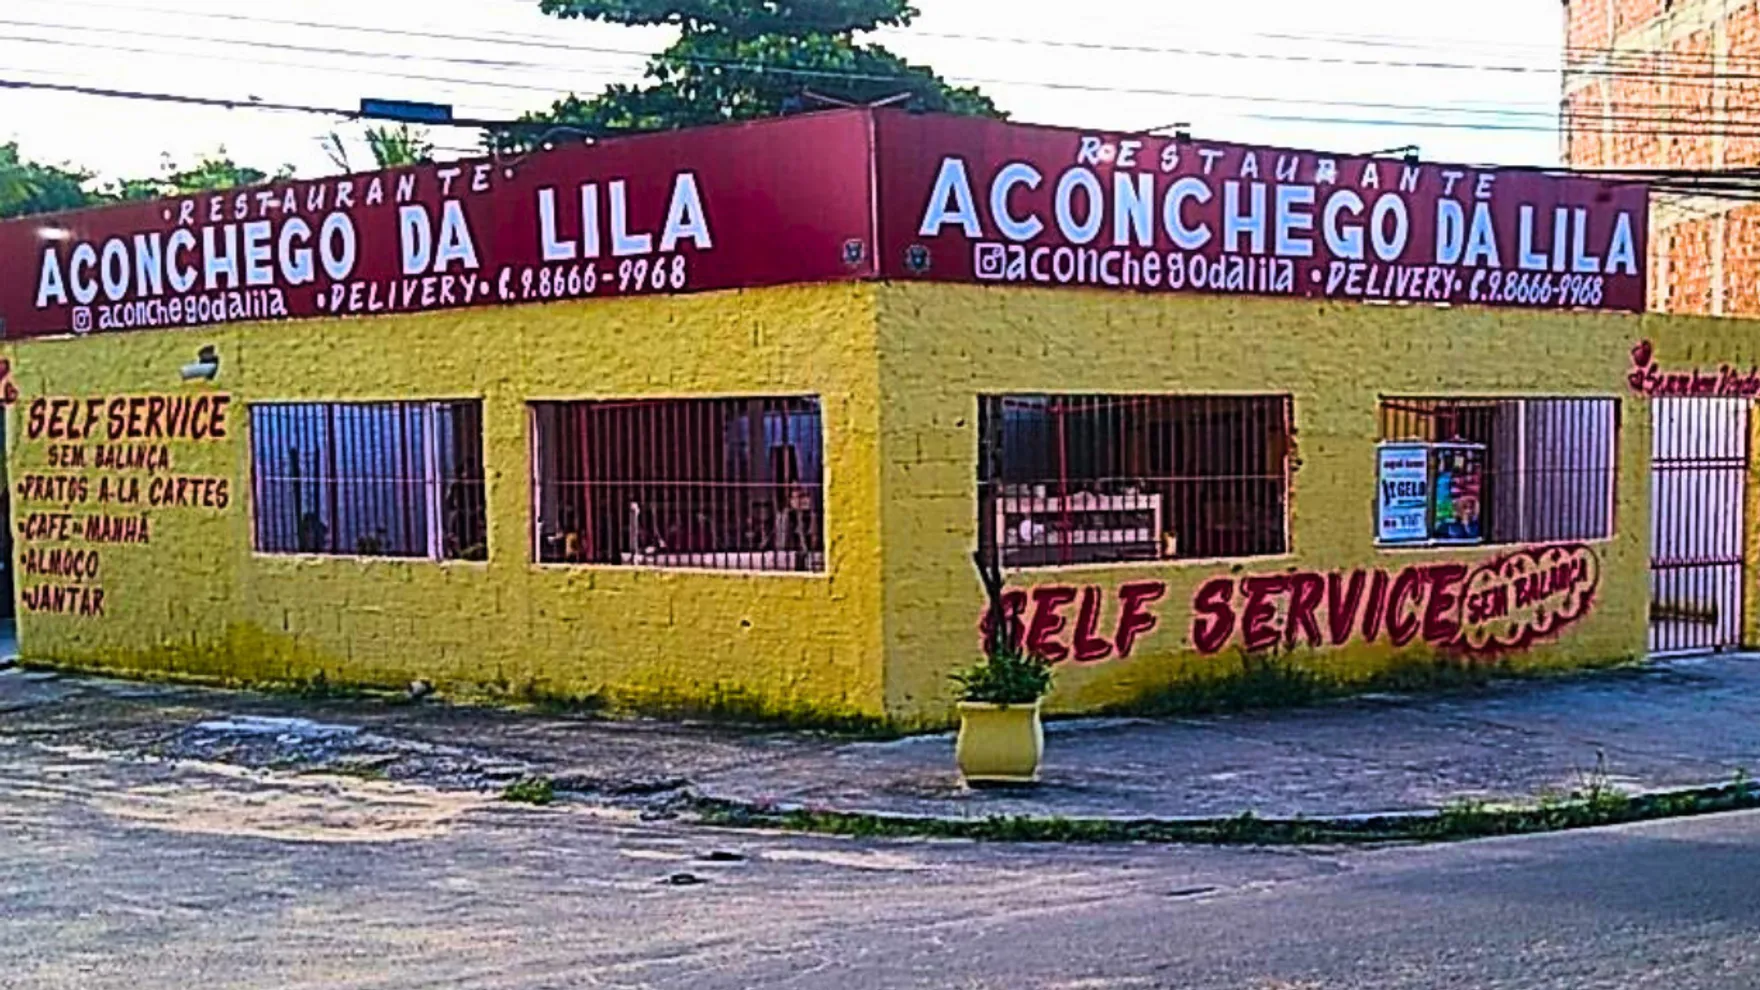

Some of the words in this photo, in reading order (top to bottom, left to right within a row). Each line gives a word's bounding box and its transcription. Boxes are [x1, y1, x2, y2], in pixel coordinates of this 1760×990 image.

[1078, 136, 1494, 197] RESTAURANTE
[178, 164, 491, 224] RESTAURANTE
[918, 157, 1409, 259] ACONCHEGO
[1436, 199, 1499, 269] DA
[1519, 206, 1637, 275] LILA
[36, 211, 356, 307] ACONCHEGO
[400, 200, 479, 275] DA
[538, 172, 712, 261] LILA
[1006, 243, 1294, 292] aconchegodalila
[1325, 260, 1455, 300] DELIVERY
[329, 273, 476, 313] DELIVERY
[27, 396, 104, 440] SELF
[106, 395, 231, 439] SERVICE
[149, 477, 229, 508] CARTES
[26, 548, 99, 583] ALMOÇO
[27, 583, 104, 616] JANTAR
[981, 582, 1164, 663] SELF
[1192, 563, 1466, 655] SERVICE
